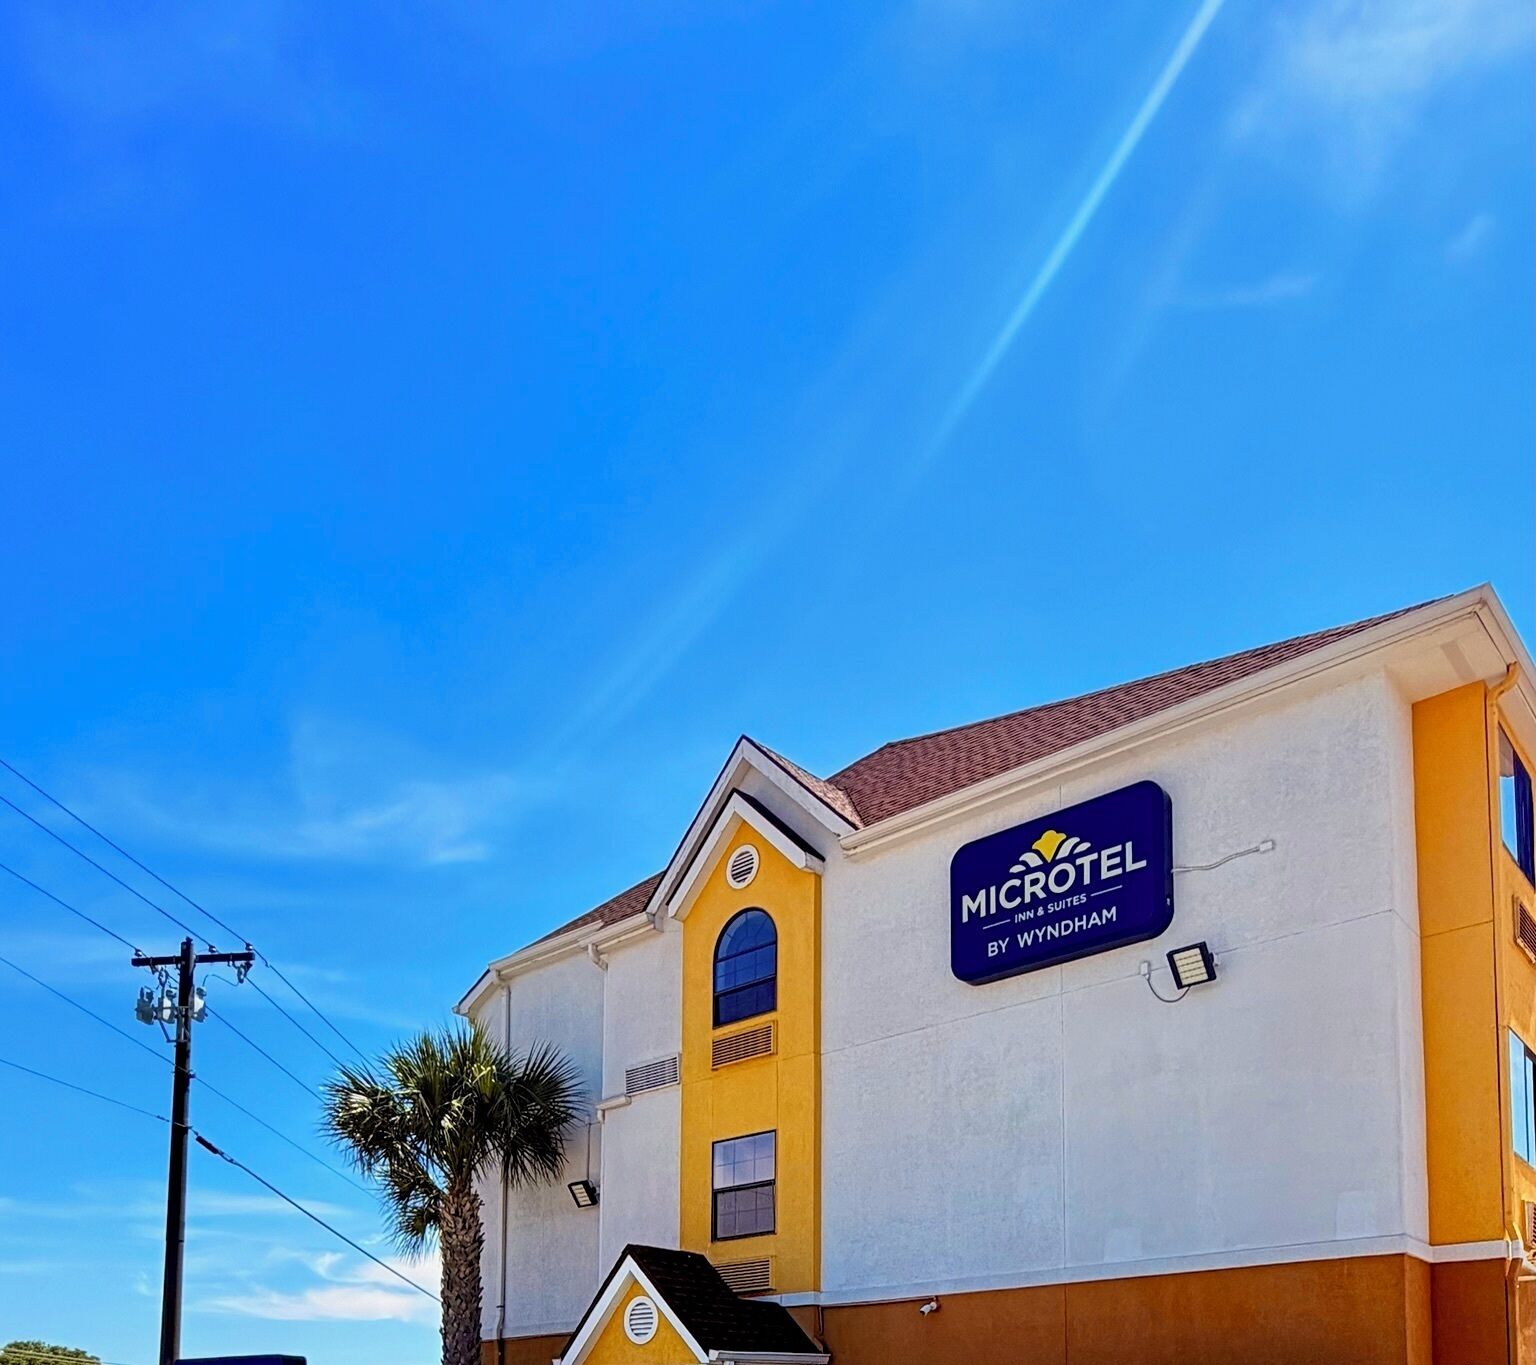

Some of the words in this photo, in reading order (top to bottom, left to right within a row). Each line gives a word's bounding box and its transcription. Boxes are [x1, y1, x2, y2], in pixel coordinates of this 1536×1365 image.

[961, 841, 1147, 924] MICROTEL
[1014, 908, 1035, 924] INN
[1036, 906, 1045, 917] &
[1047, 893, 1087, 914] SUITES
[987, 936, 1010, 958] BY
[1016, 906, 1117, 949] WYNDHAM
